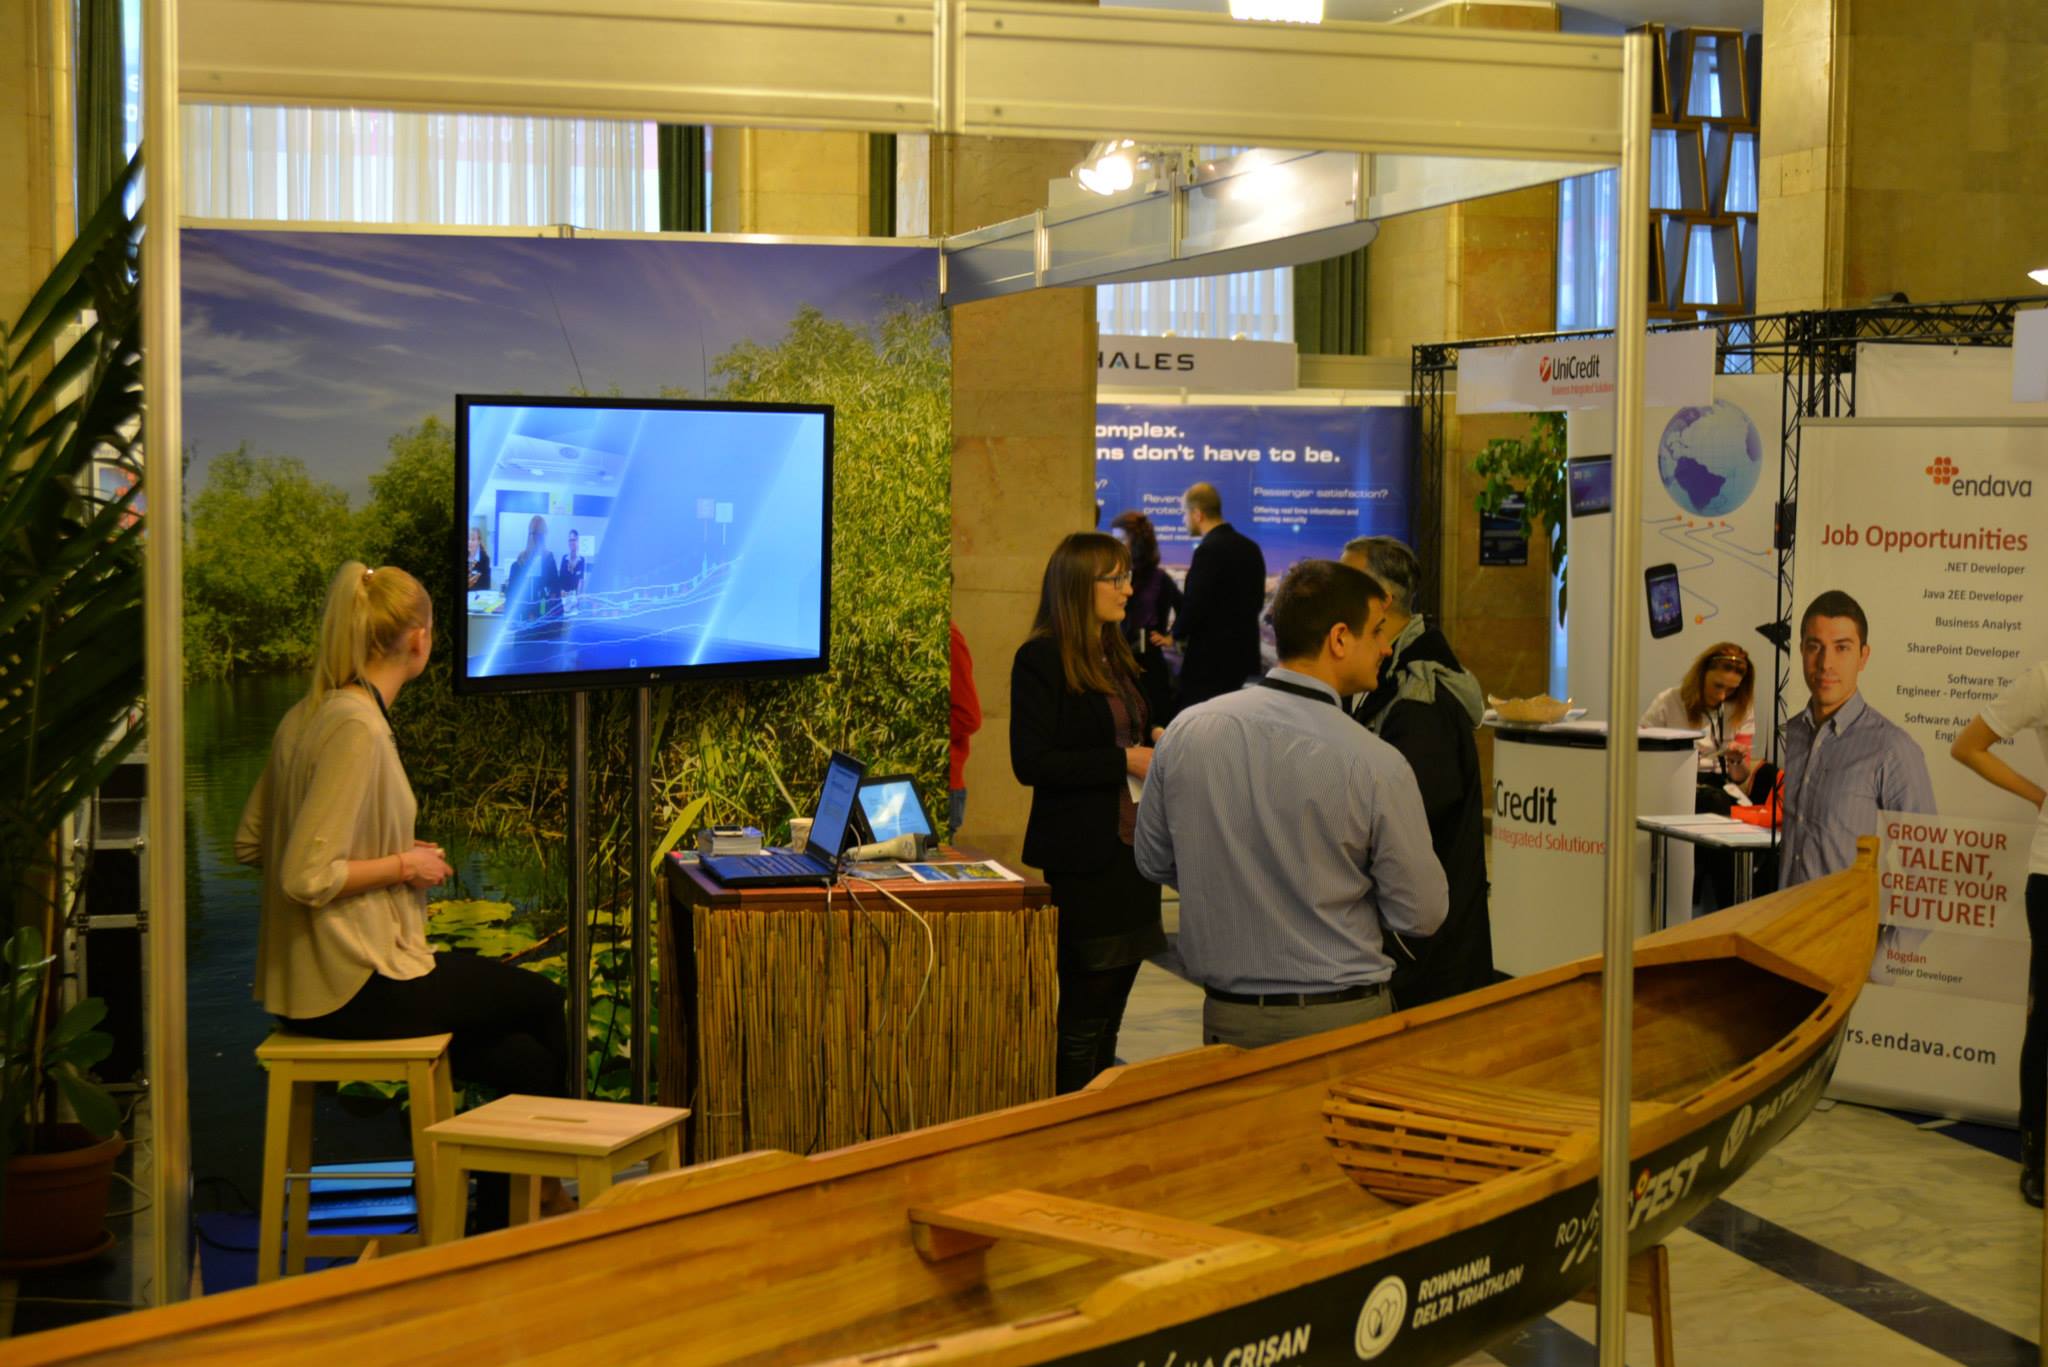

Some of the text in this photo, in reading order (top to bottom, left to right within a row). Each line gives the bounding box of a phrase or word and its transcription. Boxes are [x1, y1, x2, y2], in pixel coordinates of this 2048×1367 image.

[1552, 354, 1600, 380] UniCredit
[1096, 421, 1185, 441] omplex.
[1097, 444, 1341, 463] ns don't have to be.
[1952, 475, 2032, 498] endava
[1822, 523, 2029, 552] Job Opportunities
[1944, 562, 2025, 576] .NET Developer
[1923, 588, 2024, 604] Java 2EE Developer
[1935, 616, 2022, 632] Business Analyst
[1907, 642, 2020, 660] SharePoint Developer
[1896, 684, 1941, 698] Engineer
[1947, 673, 1994, 687] Software
[1904, 712, 1950, 726] Software
[1496, 779, 1557, 826] Credit
[1546, 833, 1607, 855] Solutions
[1887, 822, 2007, 851] GROW YOUR
[1898, 845, 1993, 881] TALENT,
[1881, 871, 2007, 902] CREATE YOUR
[1890, 894, 1996, 928] FUTURE!
[1887, 948, 1927, 964] Bogdan
[1885, 964, 1963, 984] Senior Developer
[1846, 1030, 1996, 1065] rs.endava.com
[1627, 1146, 1710, 1233] FEST
[1417, 1255, 1491, 1303] ROWMANIA
[1411, 1264, 1525, 1329] DELTA TRIATHLON
